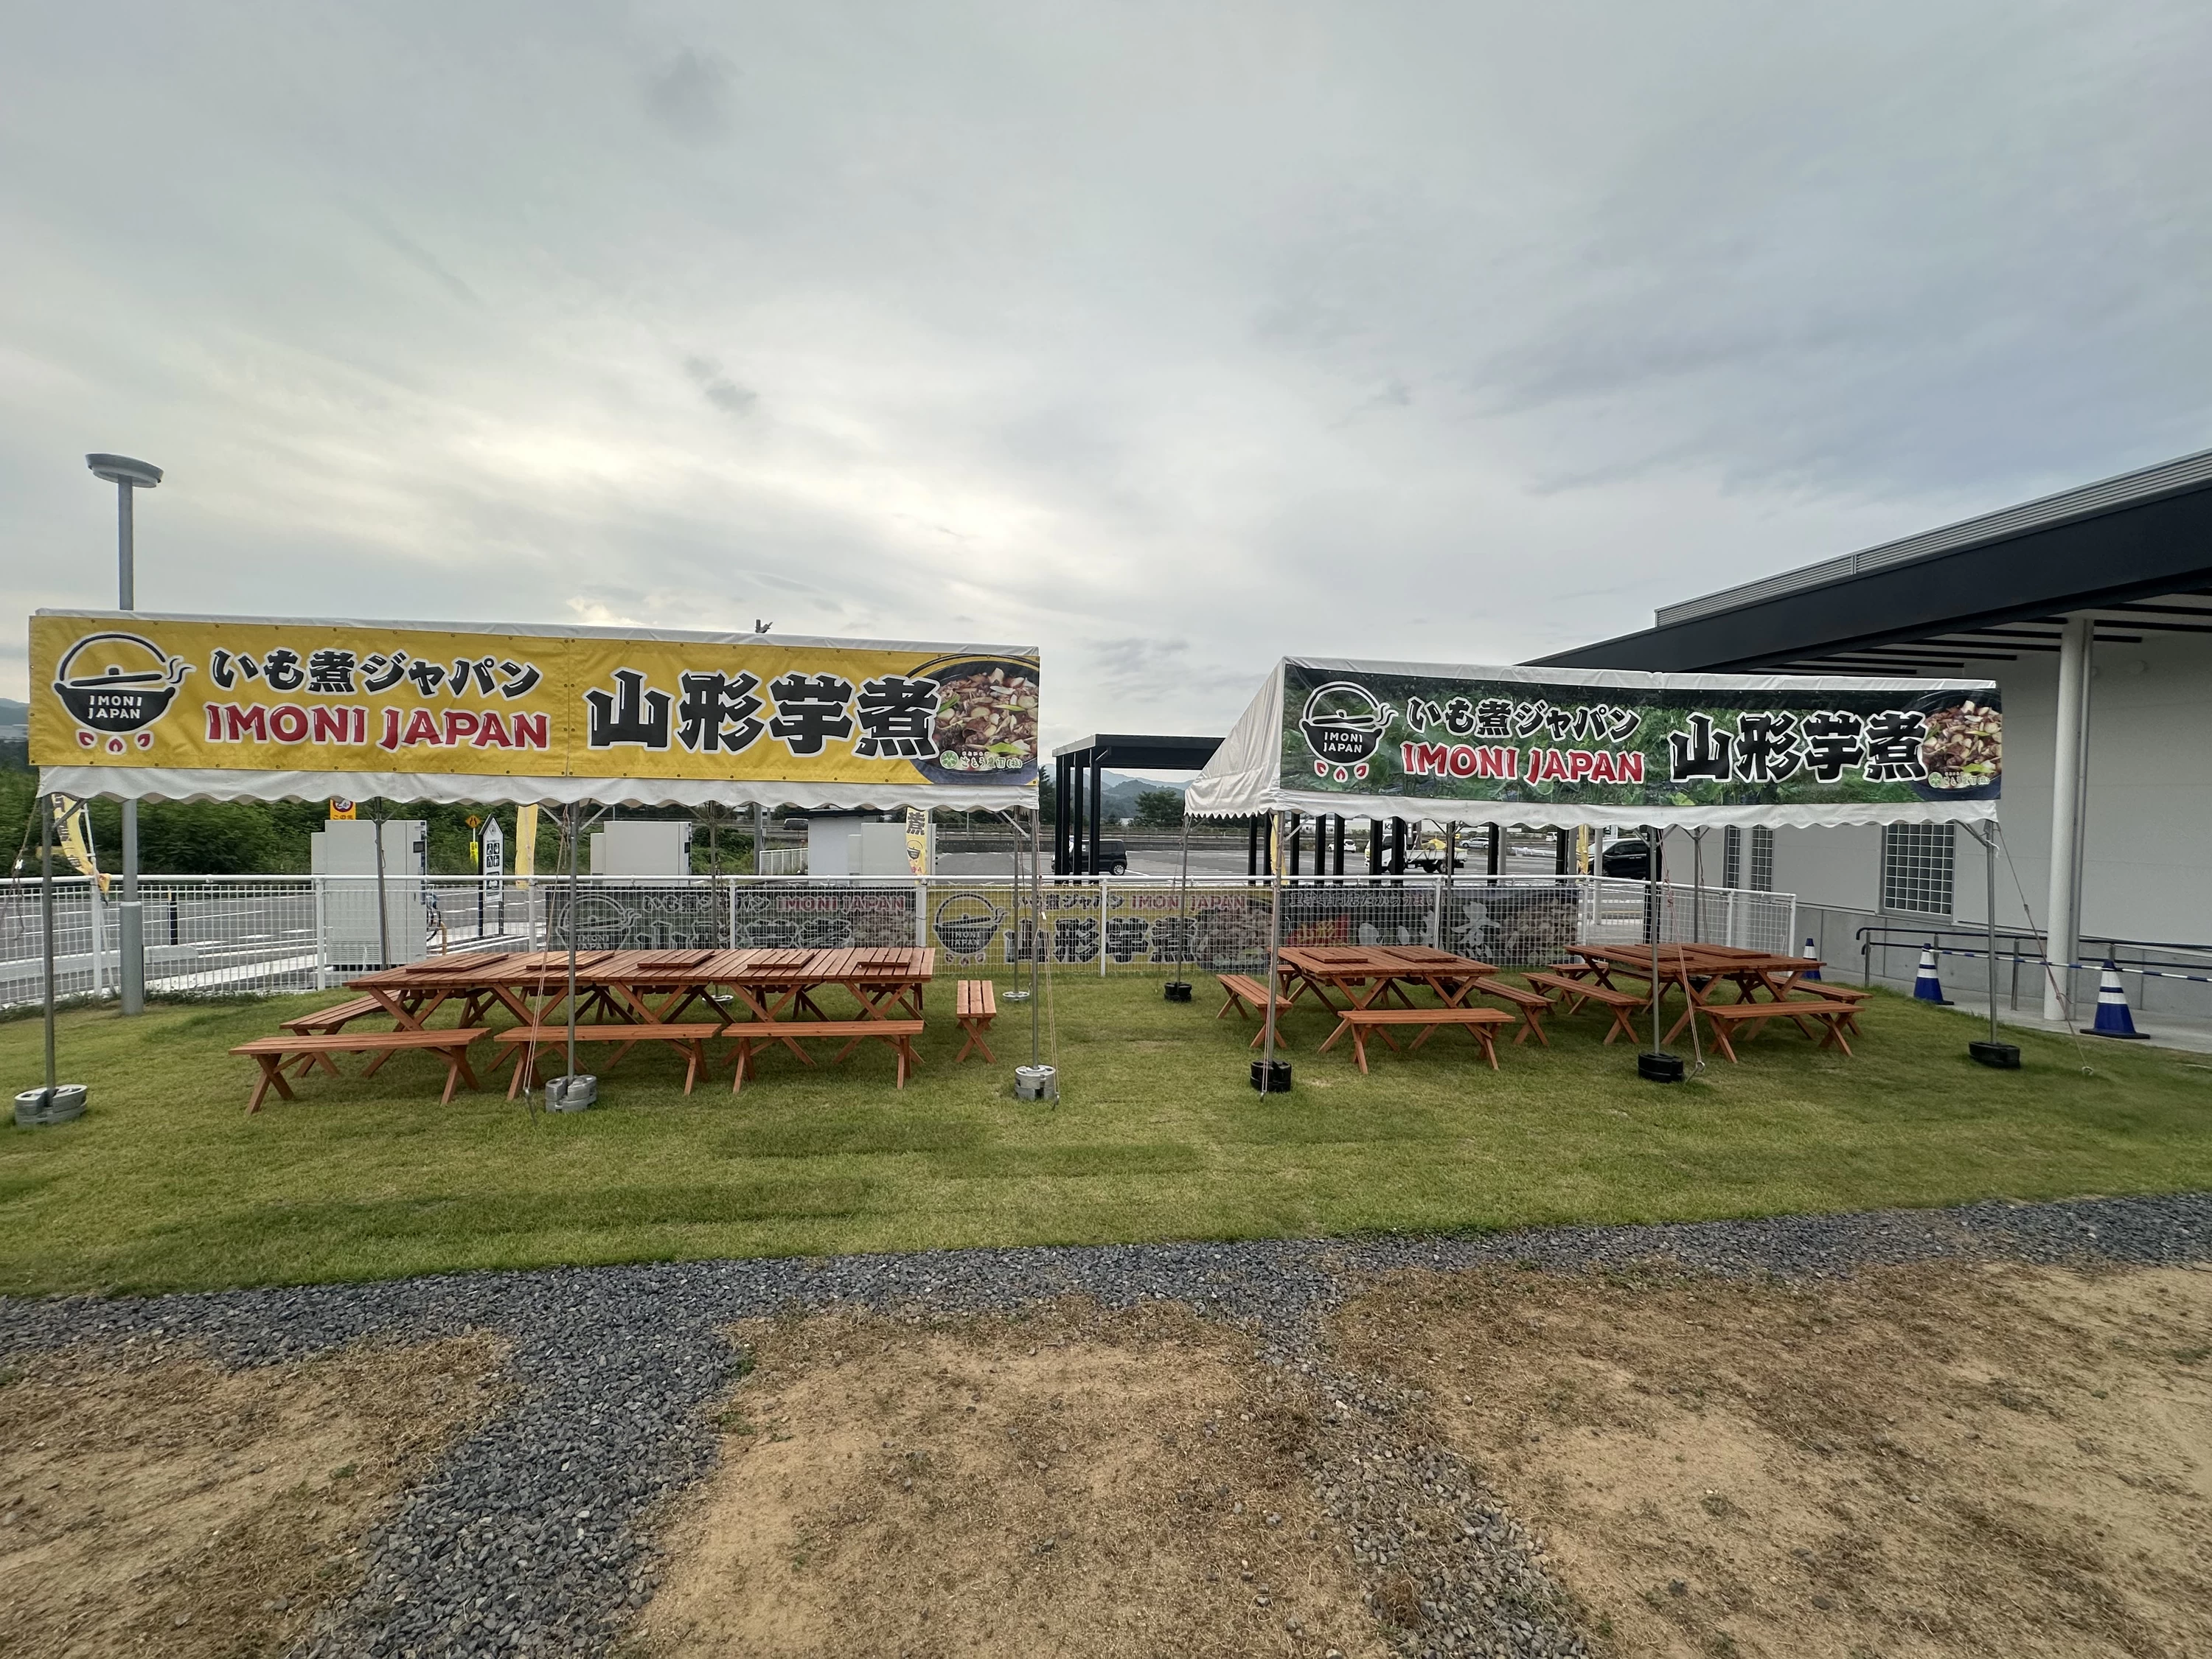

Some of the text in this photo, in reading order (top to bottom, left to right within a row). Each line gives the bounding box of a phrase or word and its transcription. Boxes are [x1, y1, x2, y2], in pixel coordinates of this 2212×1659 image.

[210, 647, 542, 698] いも煮ジャパン
[88, 695, 142, 707] IMONI
[88, 708, 141, 720] JAPAN
[586, 669, 939, 758] 山形芋煮
[205, 703, 550, 751] IMONI JAPAN
[1407, 697, 1640, 740] いも煮ジャパン
[1323, 742, 1363, 753] JAPAN
[1324, 732, 1363, 742] IMONI
[1669, 710, 1927, 782] 山形芋煮
[1402, 742, 1645, 786] IMONI JAPAN
[906, 812, 925, 835] 煮
[777, 895, 905, 913] IMONI JAPAN
[1132, 894, 1247, 910] IMON JAPAN
[1005, 917, 1198, 963] 山形芋煮
